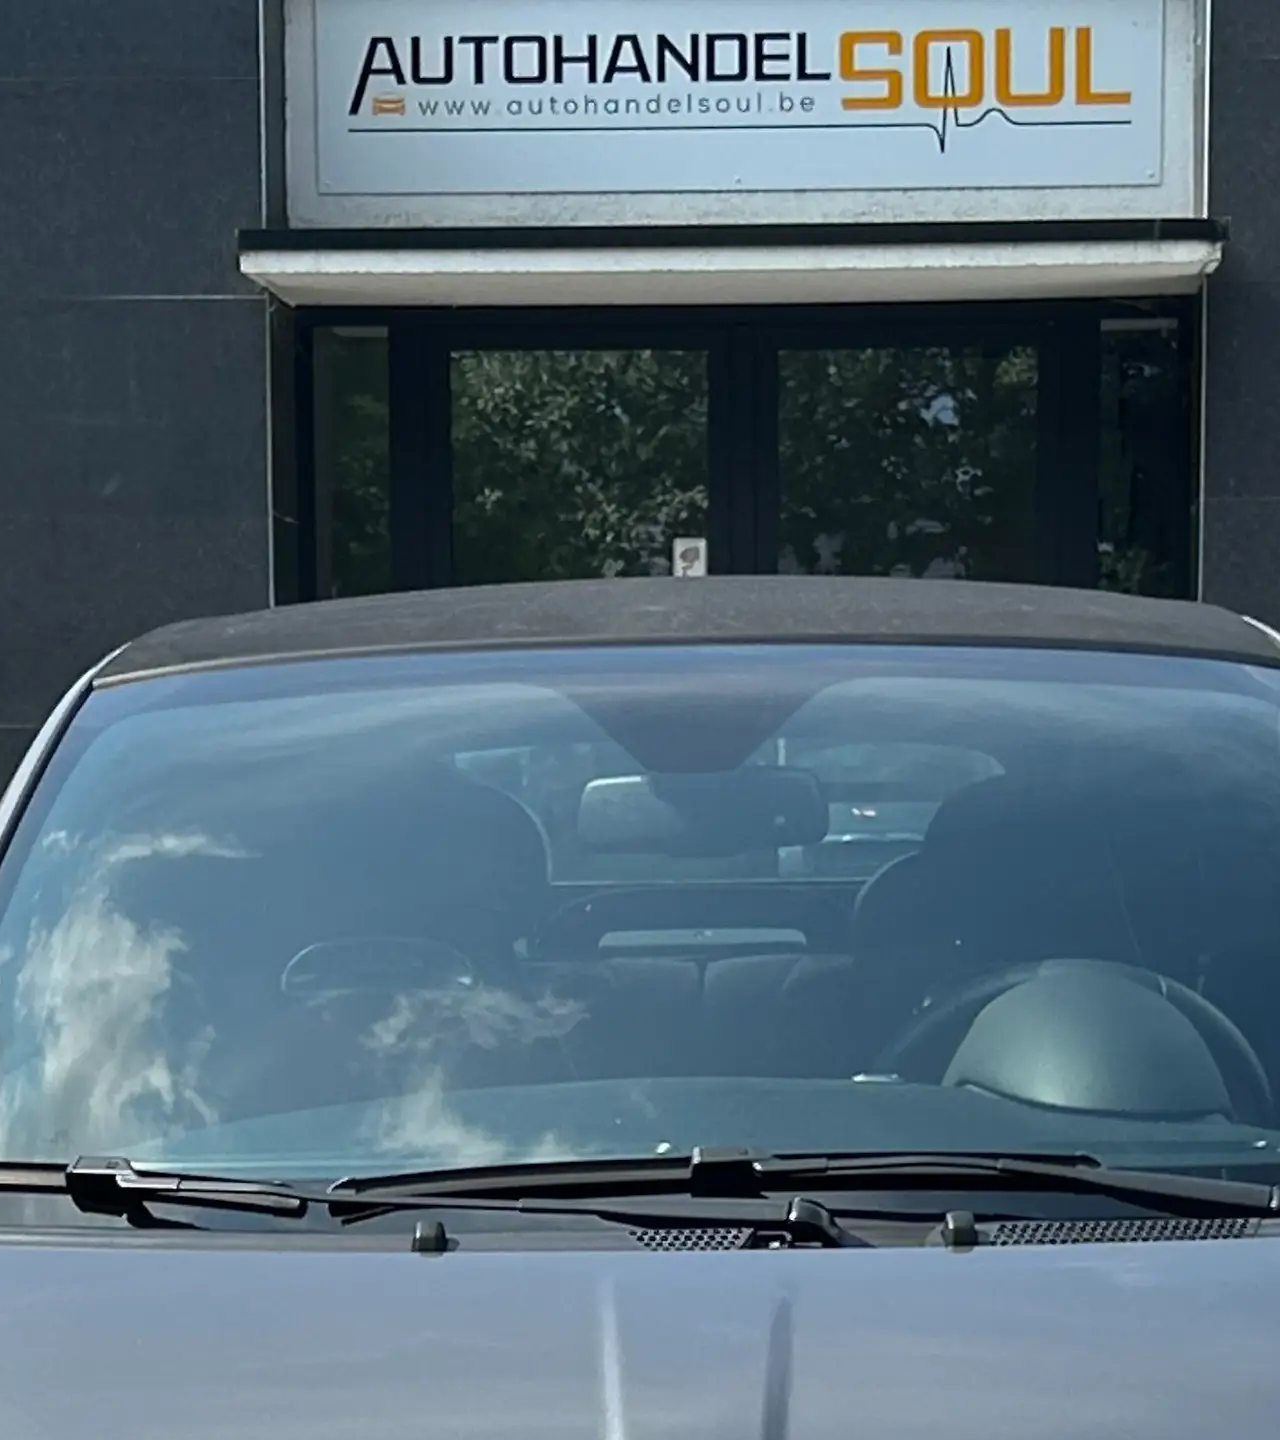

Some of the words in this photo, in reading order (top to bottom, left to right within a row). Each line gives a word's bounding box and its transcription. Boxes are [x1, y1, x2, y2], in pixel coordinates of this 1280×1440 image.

[348, 32, 832, 116] AUTOHANDEL
[839, 26, 1132, 111] SOUL
[418, 91, 817, 117] www.autohandelsoul.be
